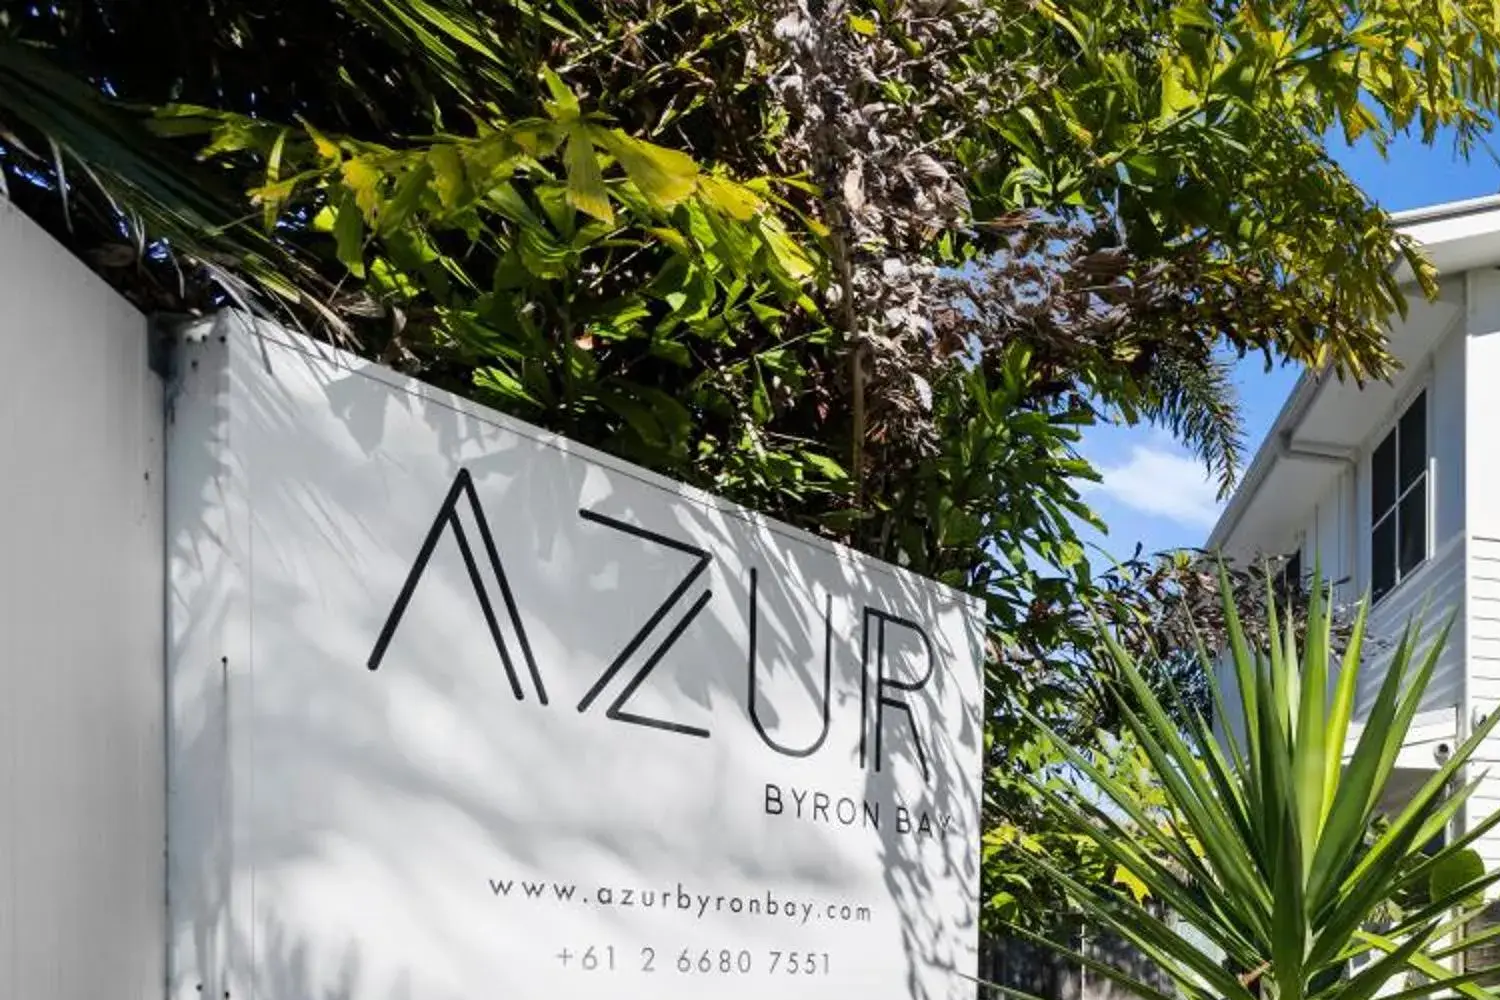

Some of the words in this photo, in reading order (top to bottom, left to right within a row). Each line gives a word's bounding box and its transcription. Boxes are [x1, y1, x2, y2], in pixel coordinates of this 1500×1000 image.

[367, 467, 935, 781] AZUR
[764, 783, 880, 831] BYRON
[895, 806, 951, 842] BAY
[488, 878, 872, 924] www.azurbyronbay.com
[555, 944, 616, 971] +61
[641, 947, 657, 972] 2
[676, 949, 752, 974] 6680
[769, 951, 832, 975] 7551
